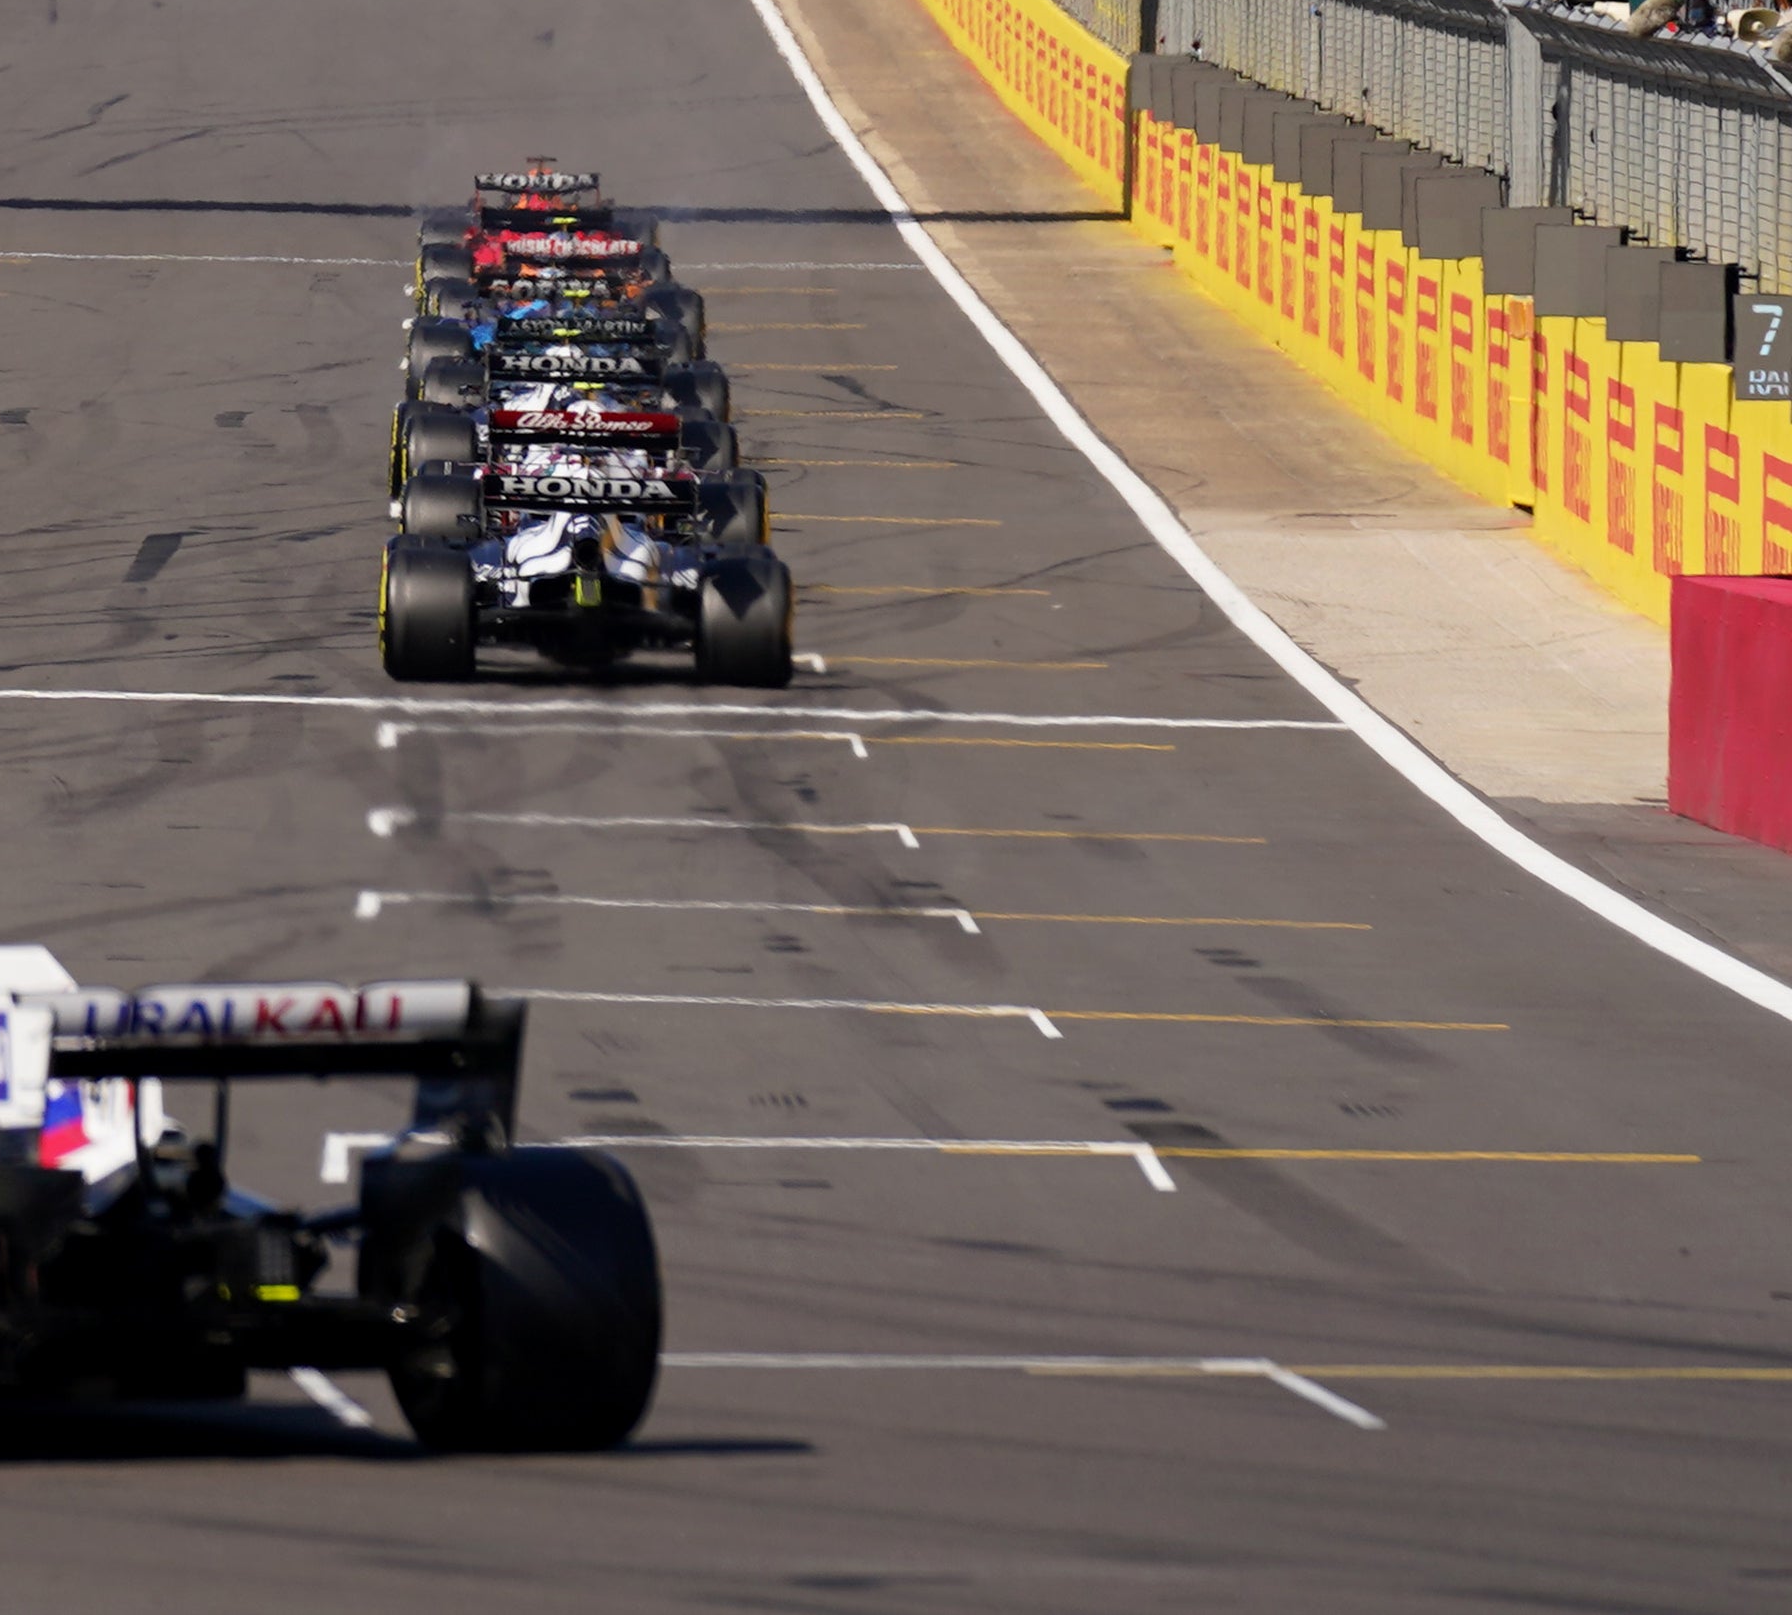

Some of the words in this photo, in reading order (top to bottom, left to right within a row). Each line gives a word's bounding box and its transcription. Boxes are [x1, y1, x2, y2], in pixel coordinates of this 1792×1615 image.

[1752, 304, 1783, 356] 7
[501, 357, 643, 373] HONDA
[499, 477, 678, 499] HONDA
